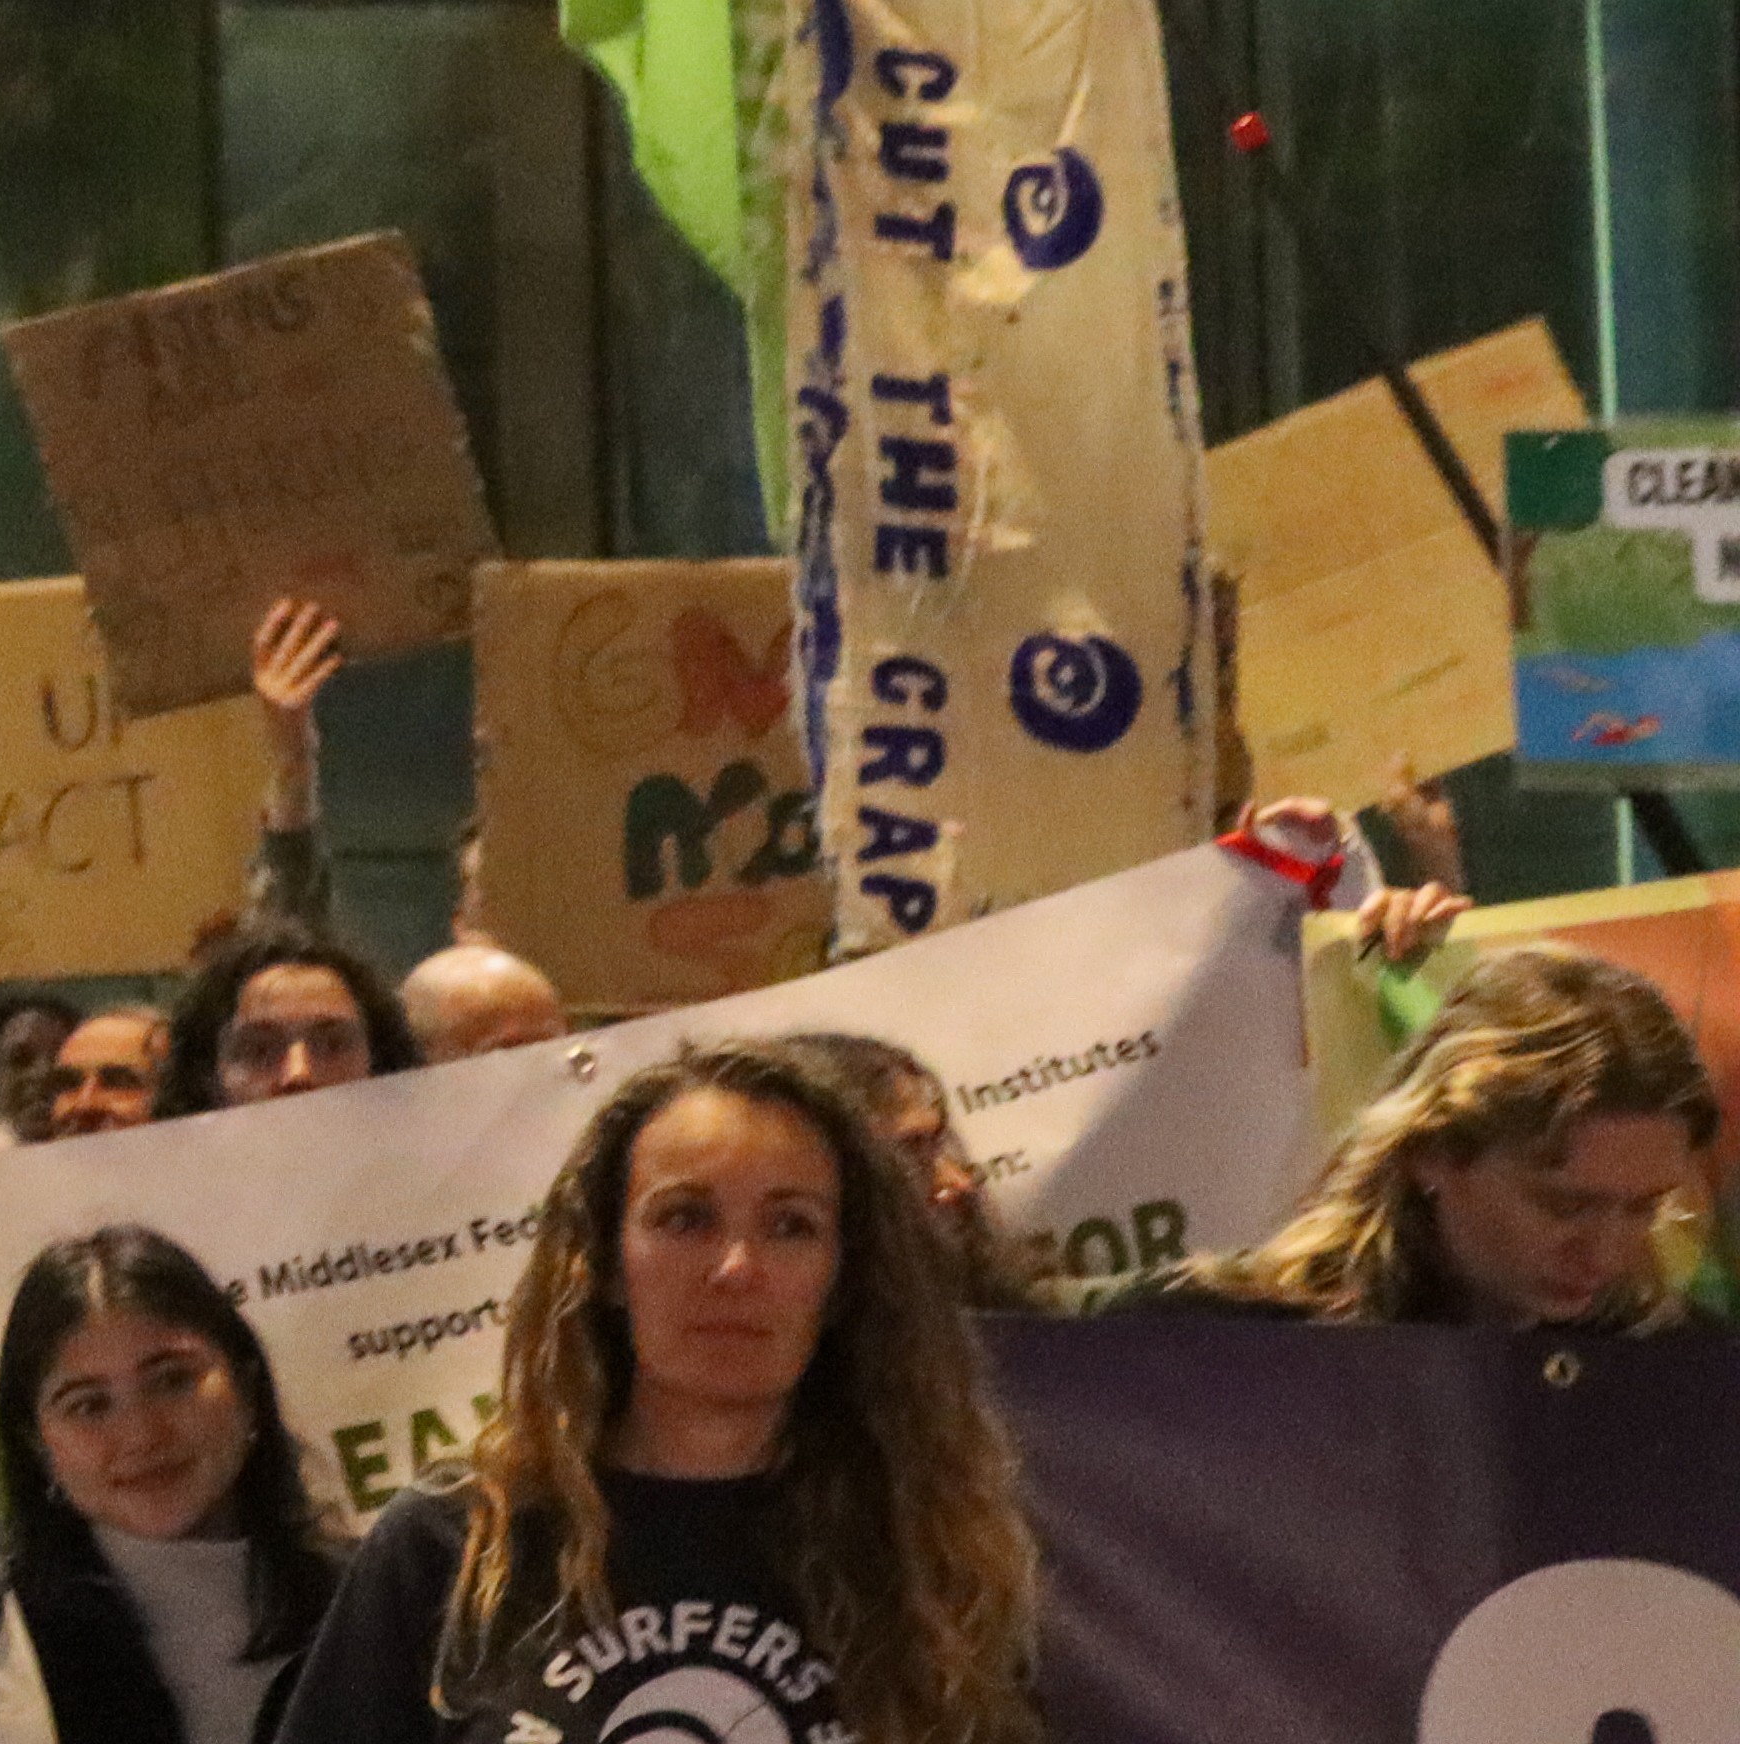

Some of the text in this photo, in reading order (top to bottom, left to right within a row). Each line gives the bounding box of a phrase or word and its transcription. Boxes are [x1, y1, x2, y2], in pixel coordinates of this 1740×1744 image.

[873, 46, 958, 262] CUT
[870, 371, 958, 580] THE
[857, 654, 950, 937] CRAP
[256, 1230, 463, 1300] Middlesex
[955, 1029, 1163, 1115] Institutes
[545, 1600, 836, 1703] SURFERS
